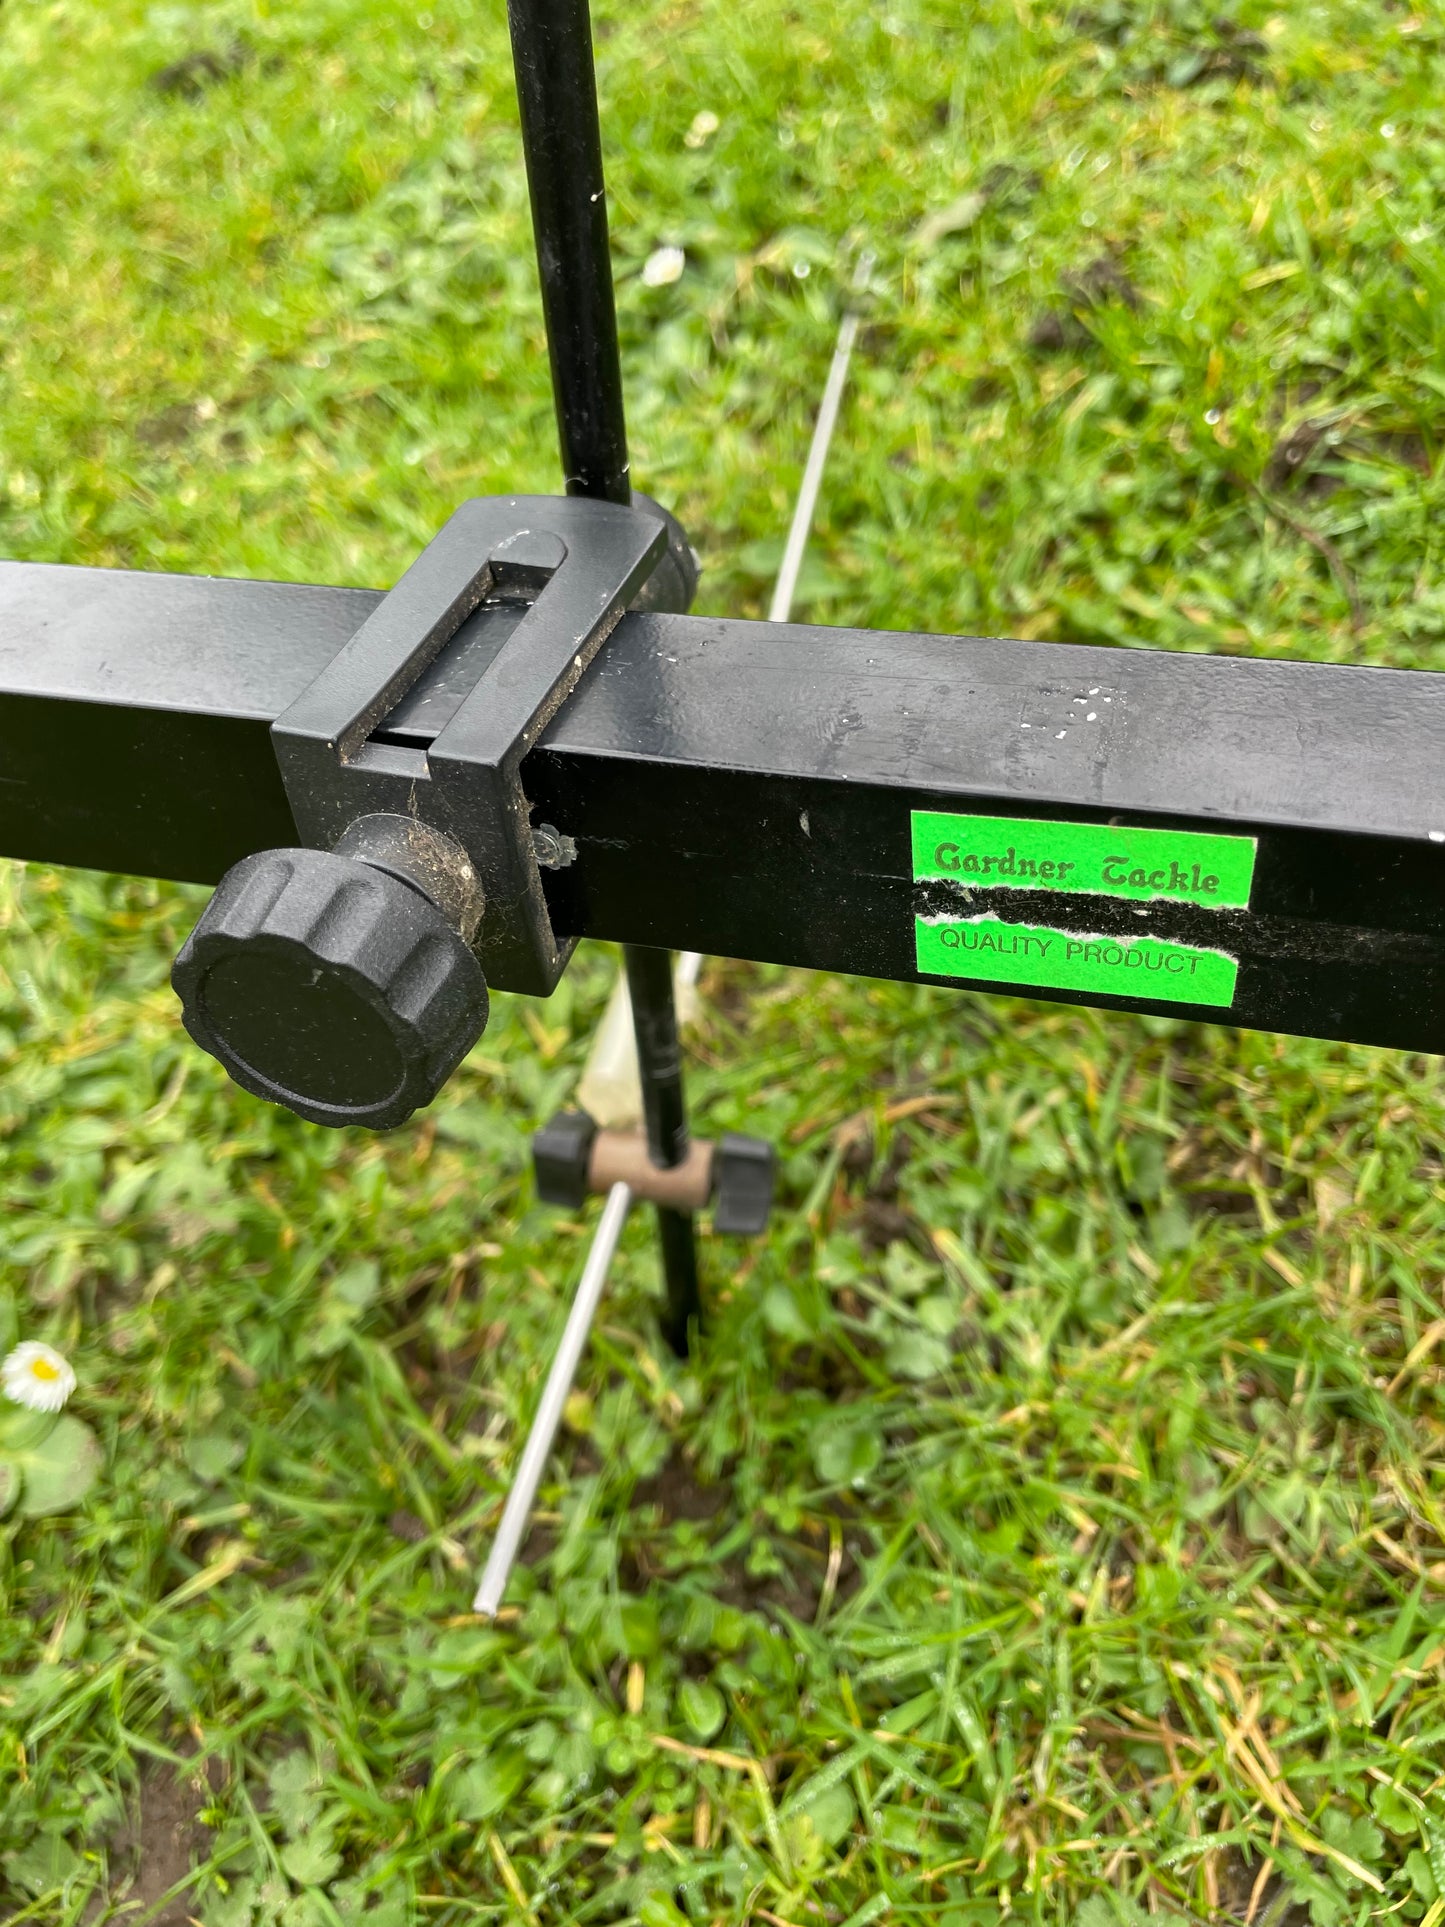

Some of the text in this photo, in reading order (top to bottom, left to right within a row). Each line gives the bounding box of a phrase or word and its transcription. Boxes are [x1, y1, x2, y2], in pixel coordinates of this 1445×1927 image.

[934, 842, 1220, 895] Gardner Tackle
[940, 928, 1204, 975] QUALITY PRODUCT
